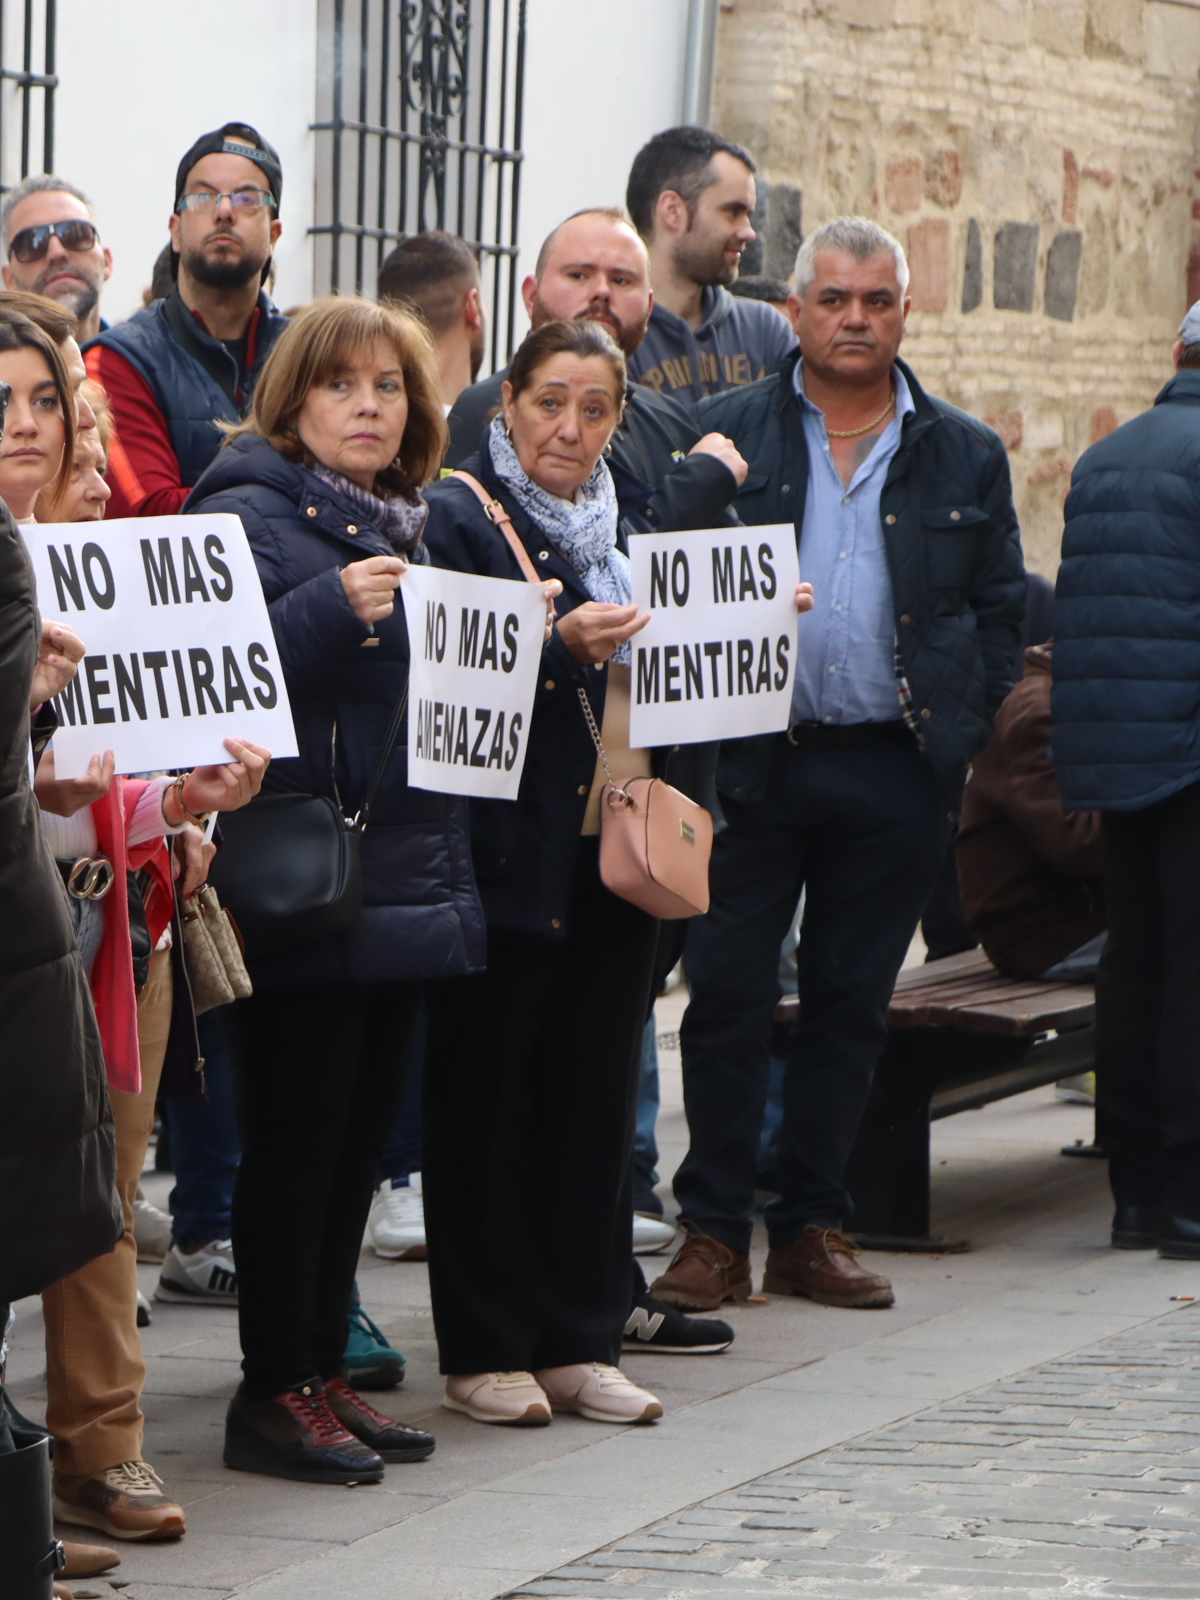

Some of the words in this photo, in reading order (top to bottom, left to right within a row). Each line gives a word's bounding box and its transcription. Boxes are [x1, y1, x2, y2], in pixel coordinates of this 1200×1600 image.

[47, 541, 116, 612] NO
[140, 534, 234, 607] MAS
[650, 548, 690, 609] NO
[711, 542, 778, 604] MAS
[424, 600, 447, 664] NO
[458, 607, 520, 674] MAS
[637, 634, 790, 705] MENTIRAS
[52, 642, 278, 727] MENTIRAS
[416, 698, 523, 772] AMENAZAS
[623, 1306, 666, 1342] N
